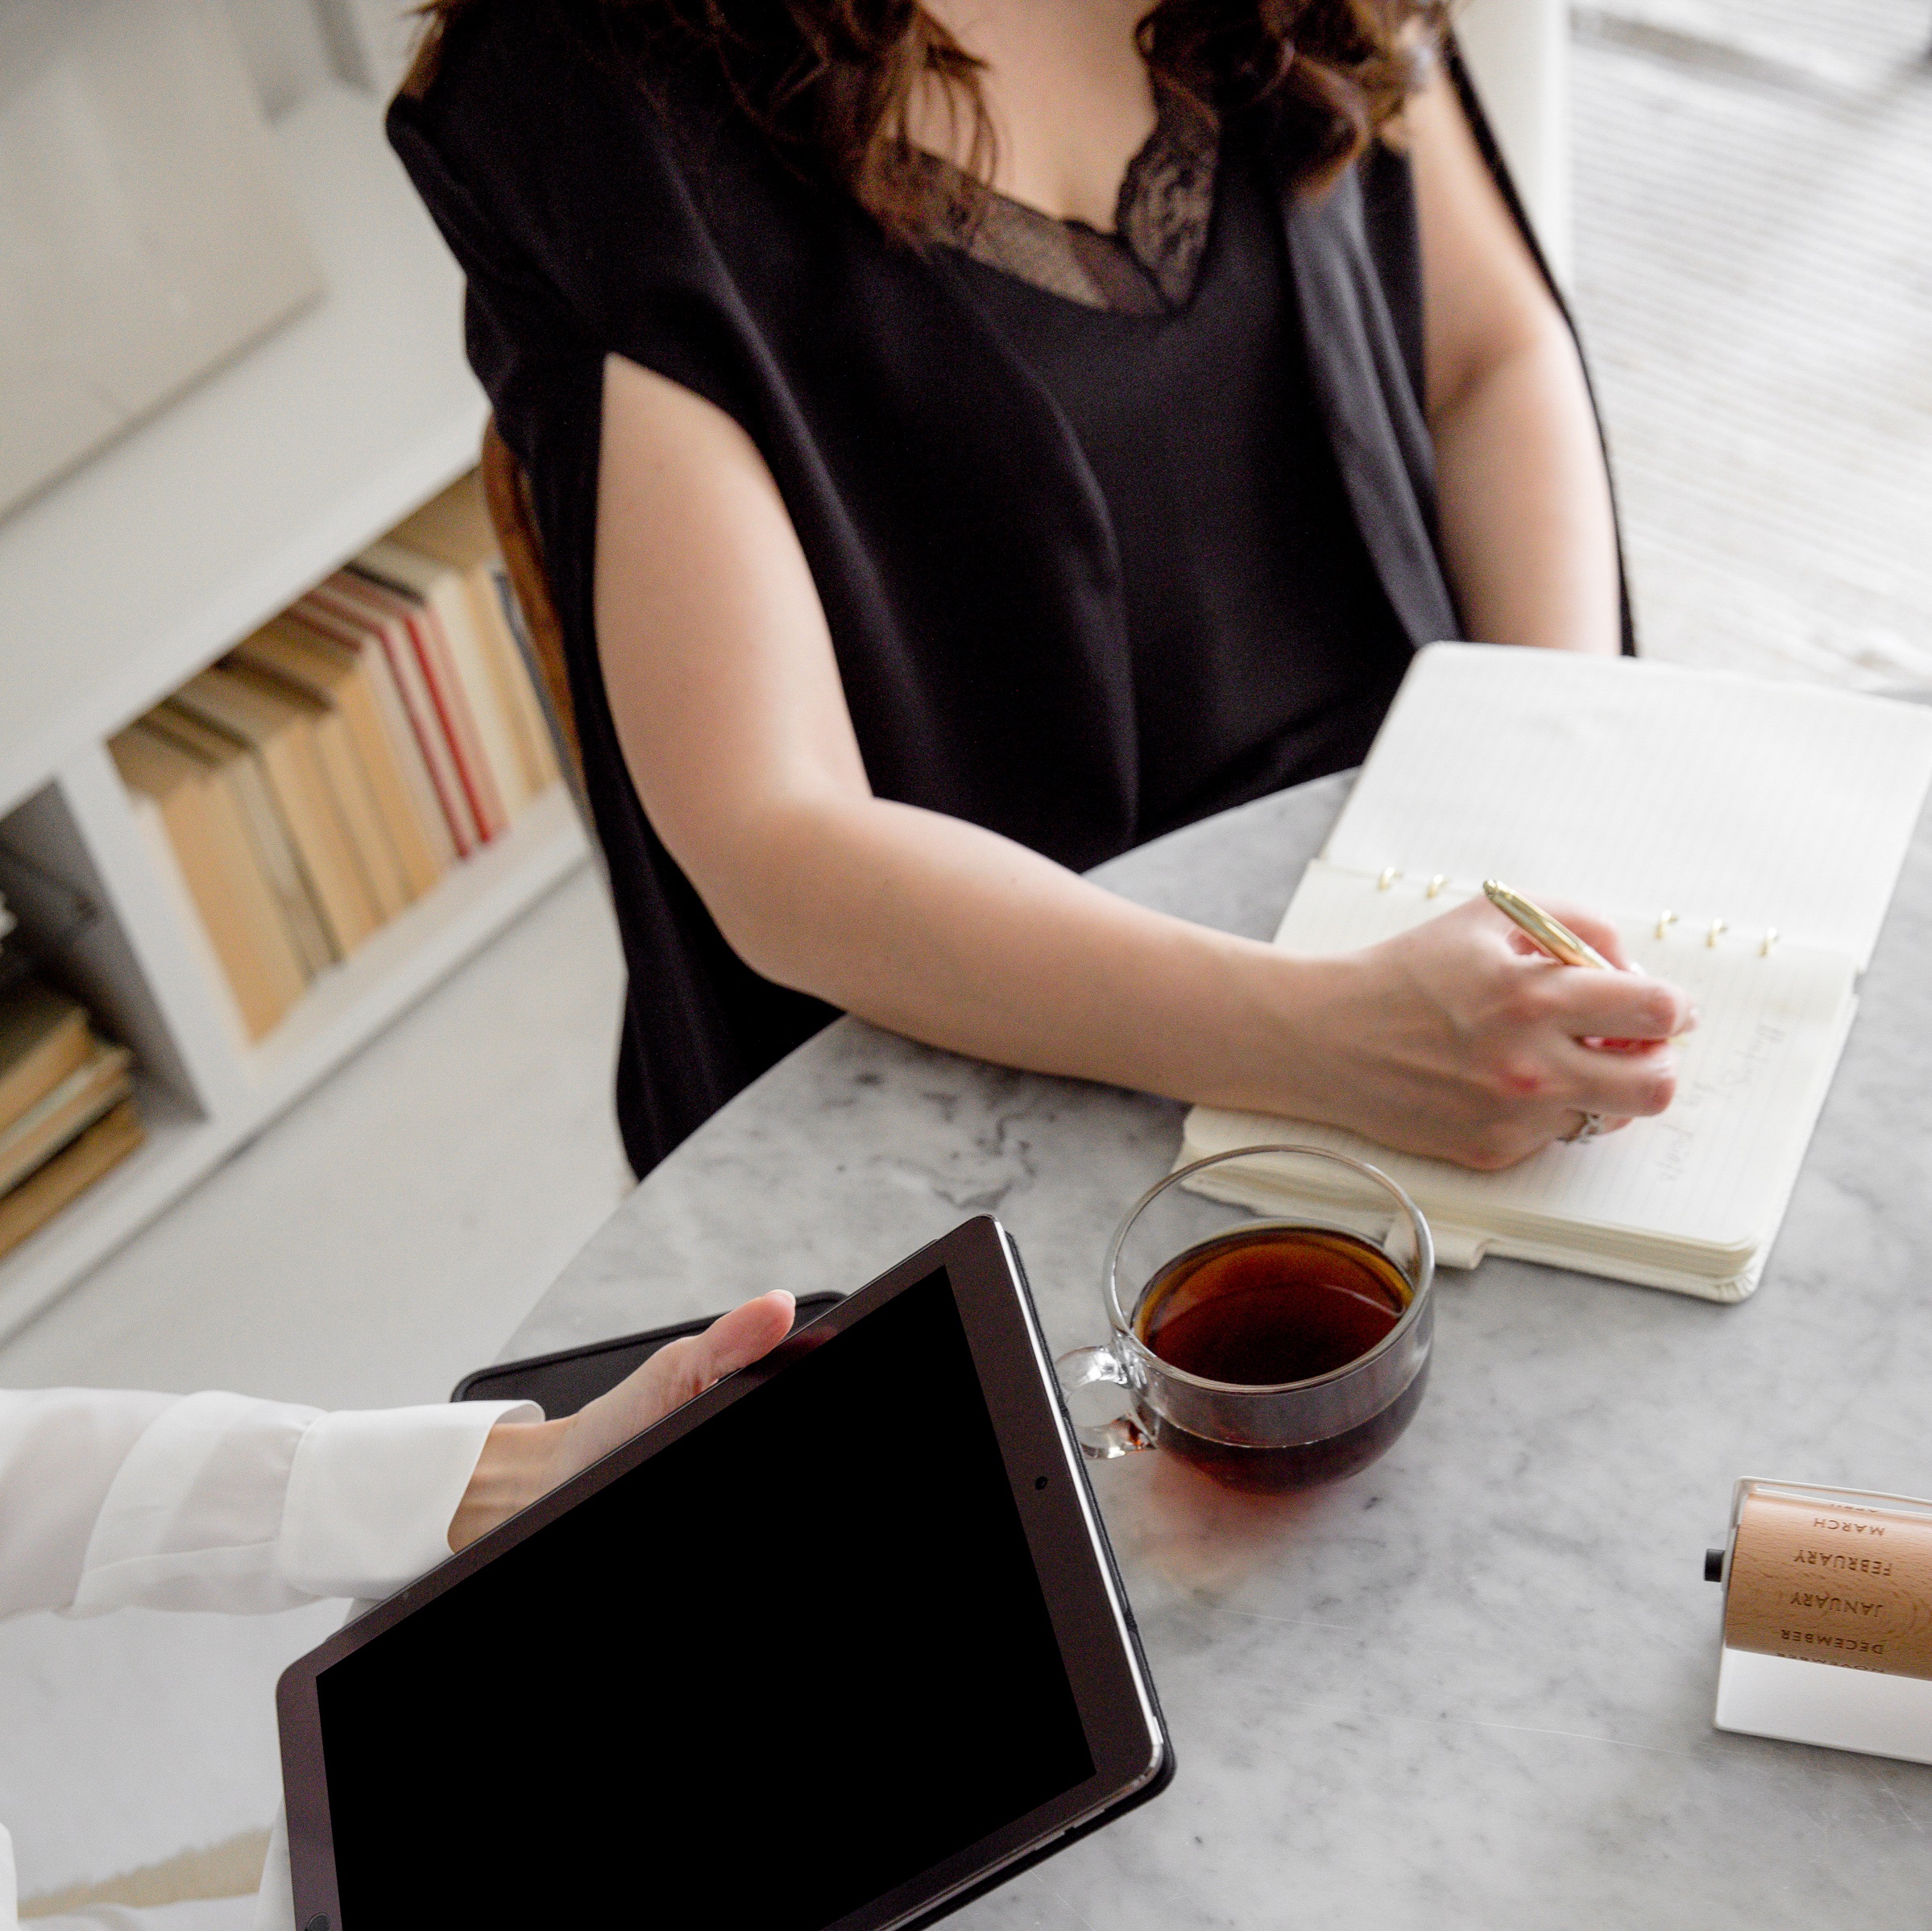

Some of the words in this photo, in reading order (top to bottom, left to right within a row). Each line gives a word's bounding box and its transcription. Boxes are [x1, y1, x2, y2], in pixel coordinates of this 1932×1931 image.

[1814, 1518, 1885, 1536] MARCH
[1793, 1549, 1893, 1577] FEBRUARY
[1790, 1591, 1884, 1618] JANUARY
[1780, 1629, 1884, 1655] DECEMBER
